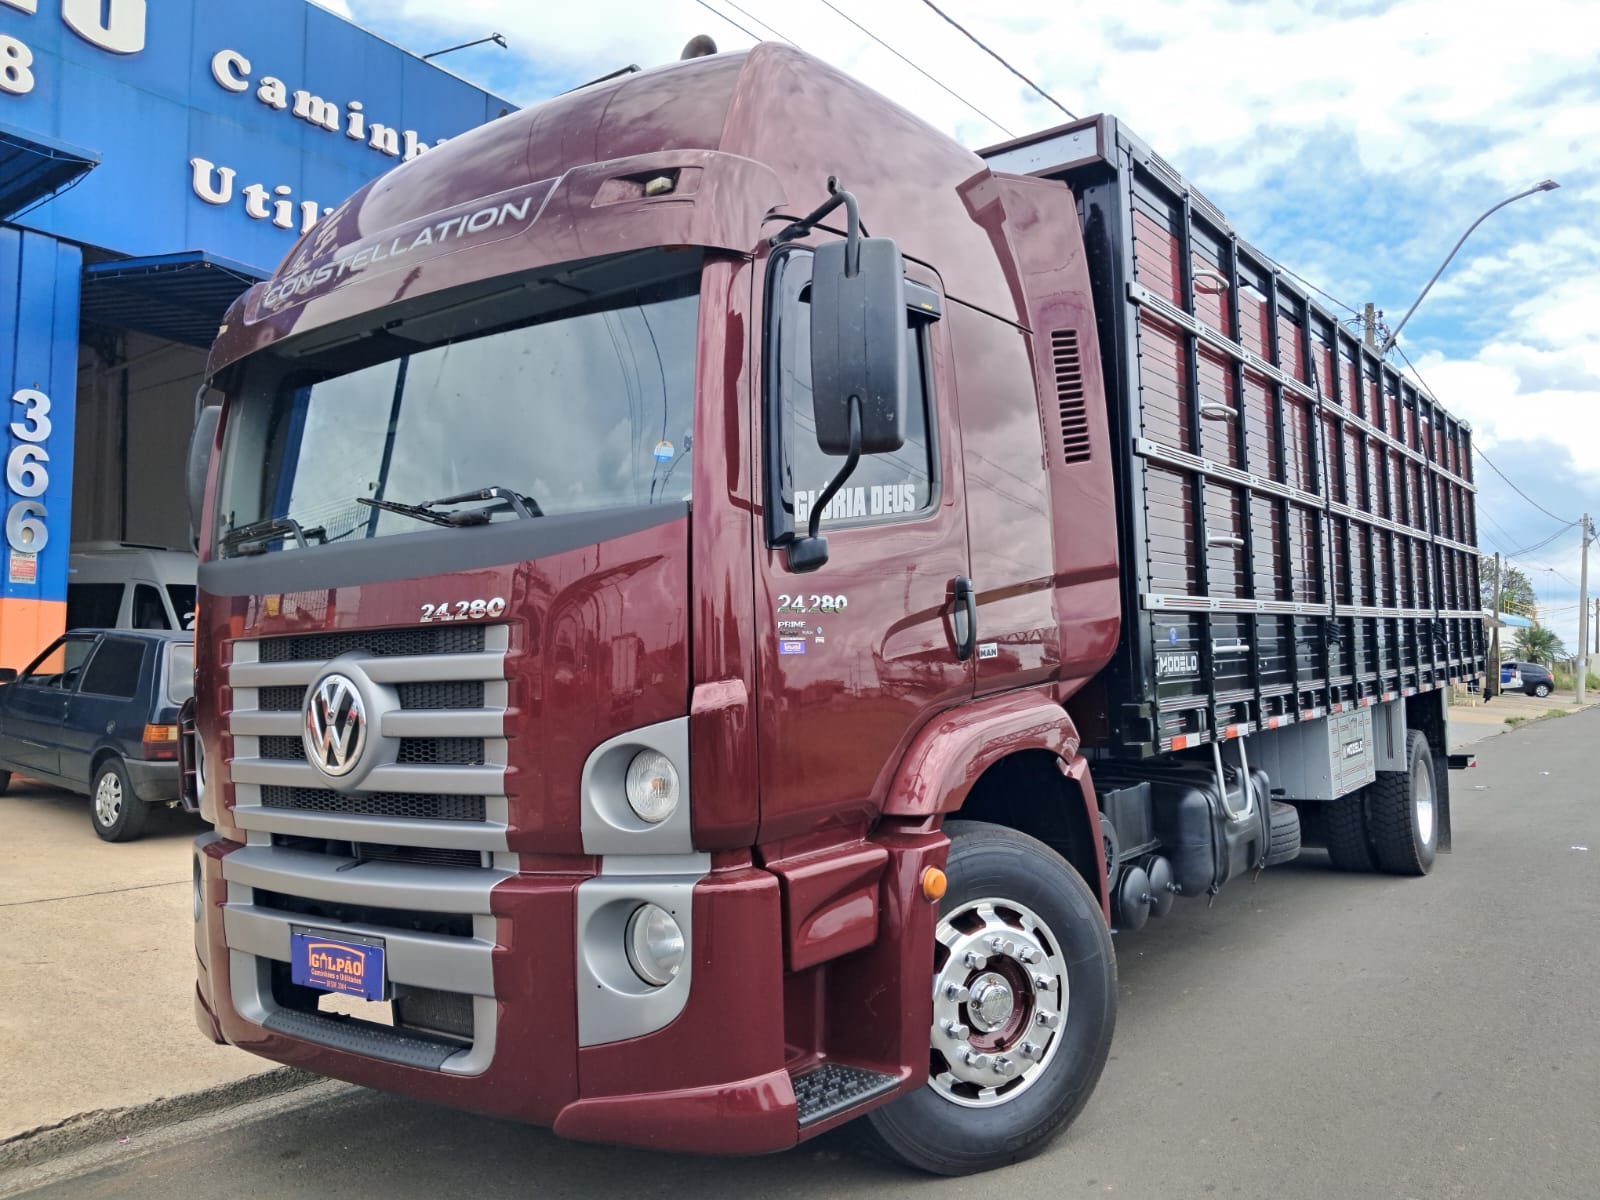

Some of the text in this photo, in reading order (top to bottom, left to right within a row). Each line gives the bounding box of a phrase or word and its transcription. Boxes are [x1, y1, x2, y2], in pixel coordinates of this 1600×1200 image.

[211, 49, 448, 162] Caminh
[190, 157, 334, 236] Util
[263, 197, 532, 308] CONSTELLATION
[870, 484, 915, 515] DEUS
[1159, 655, 1197, 673] MODELO
